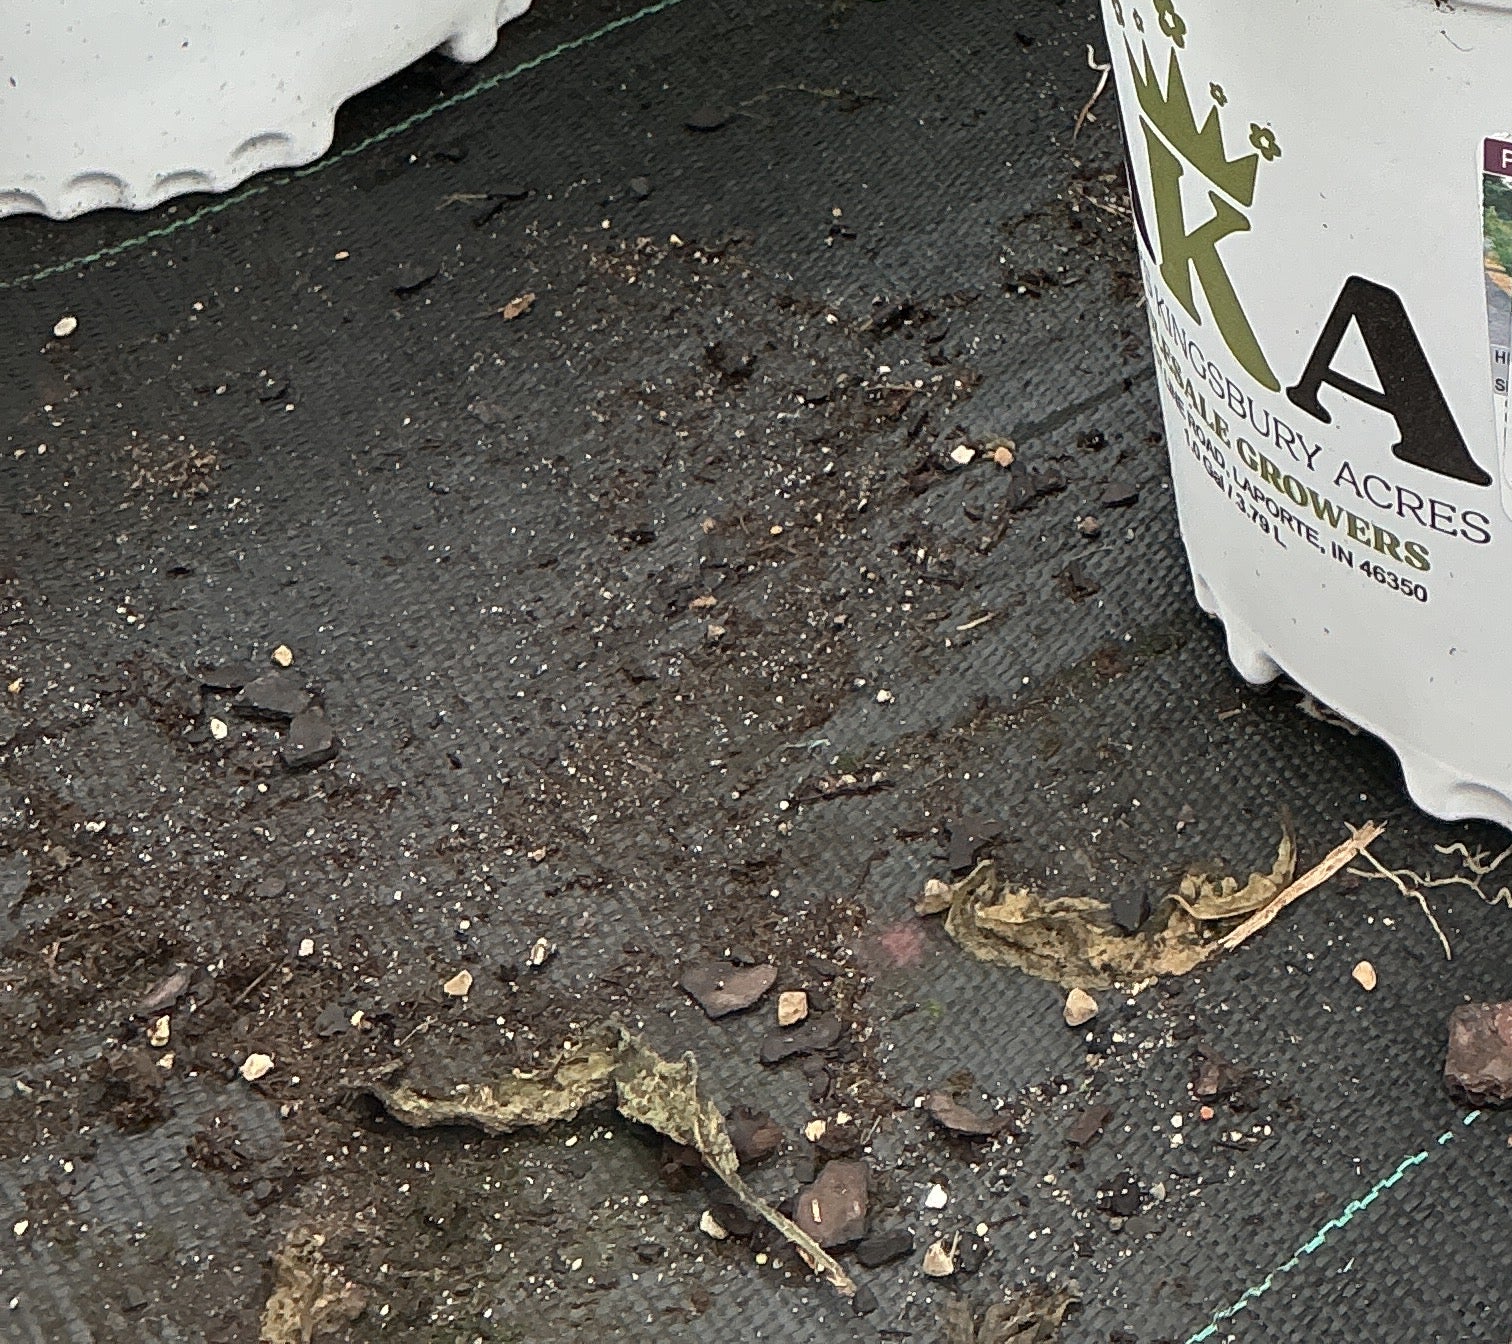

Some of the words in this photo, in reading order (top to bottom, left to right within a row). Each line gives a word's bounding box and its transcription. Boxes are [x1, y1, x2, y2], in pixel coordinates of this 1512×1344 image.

[1154, 285, 1323, 472] KINGSBURY
[1332, 460, 1492, 545] ACRES
[1231, 465, 1326, 554] LAPORTE,
[1331, 541, 1354, 569] IN
[1358, 560, 1429, 603] 46350
[1234, 493, 1271, 536] 3.79
[1273, 524, 1288, 550] L
[1235, 436, 1432, 573] GROWERS
